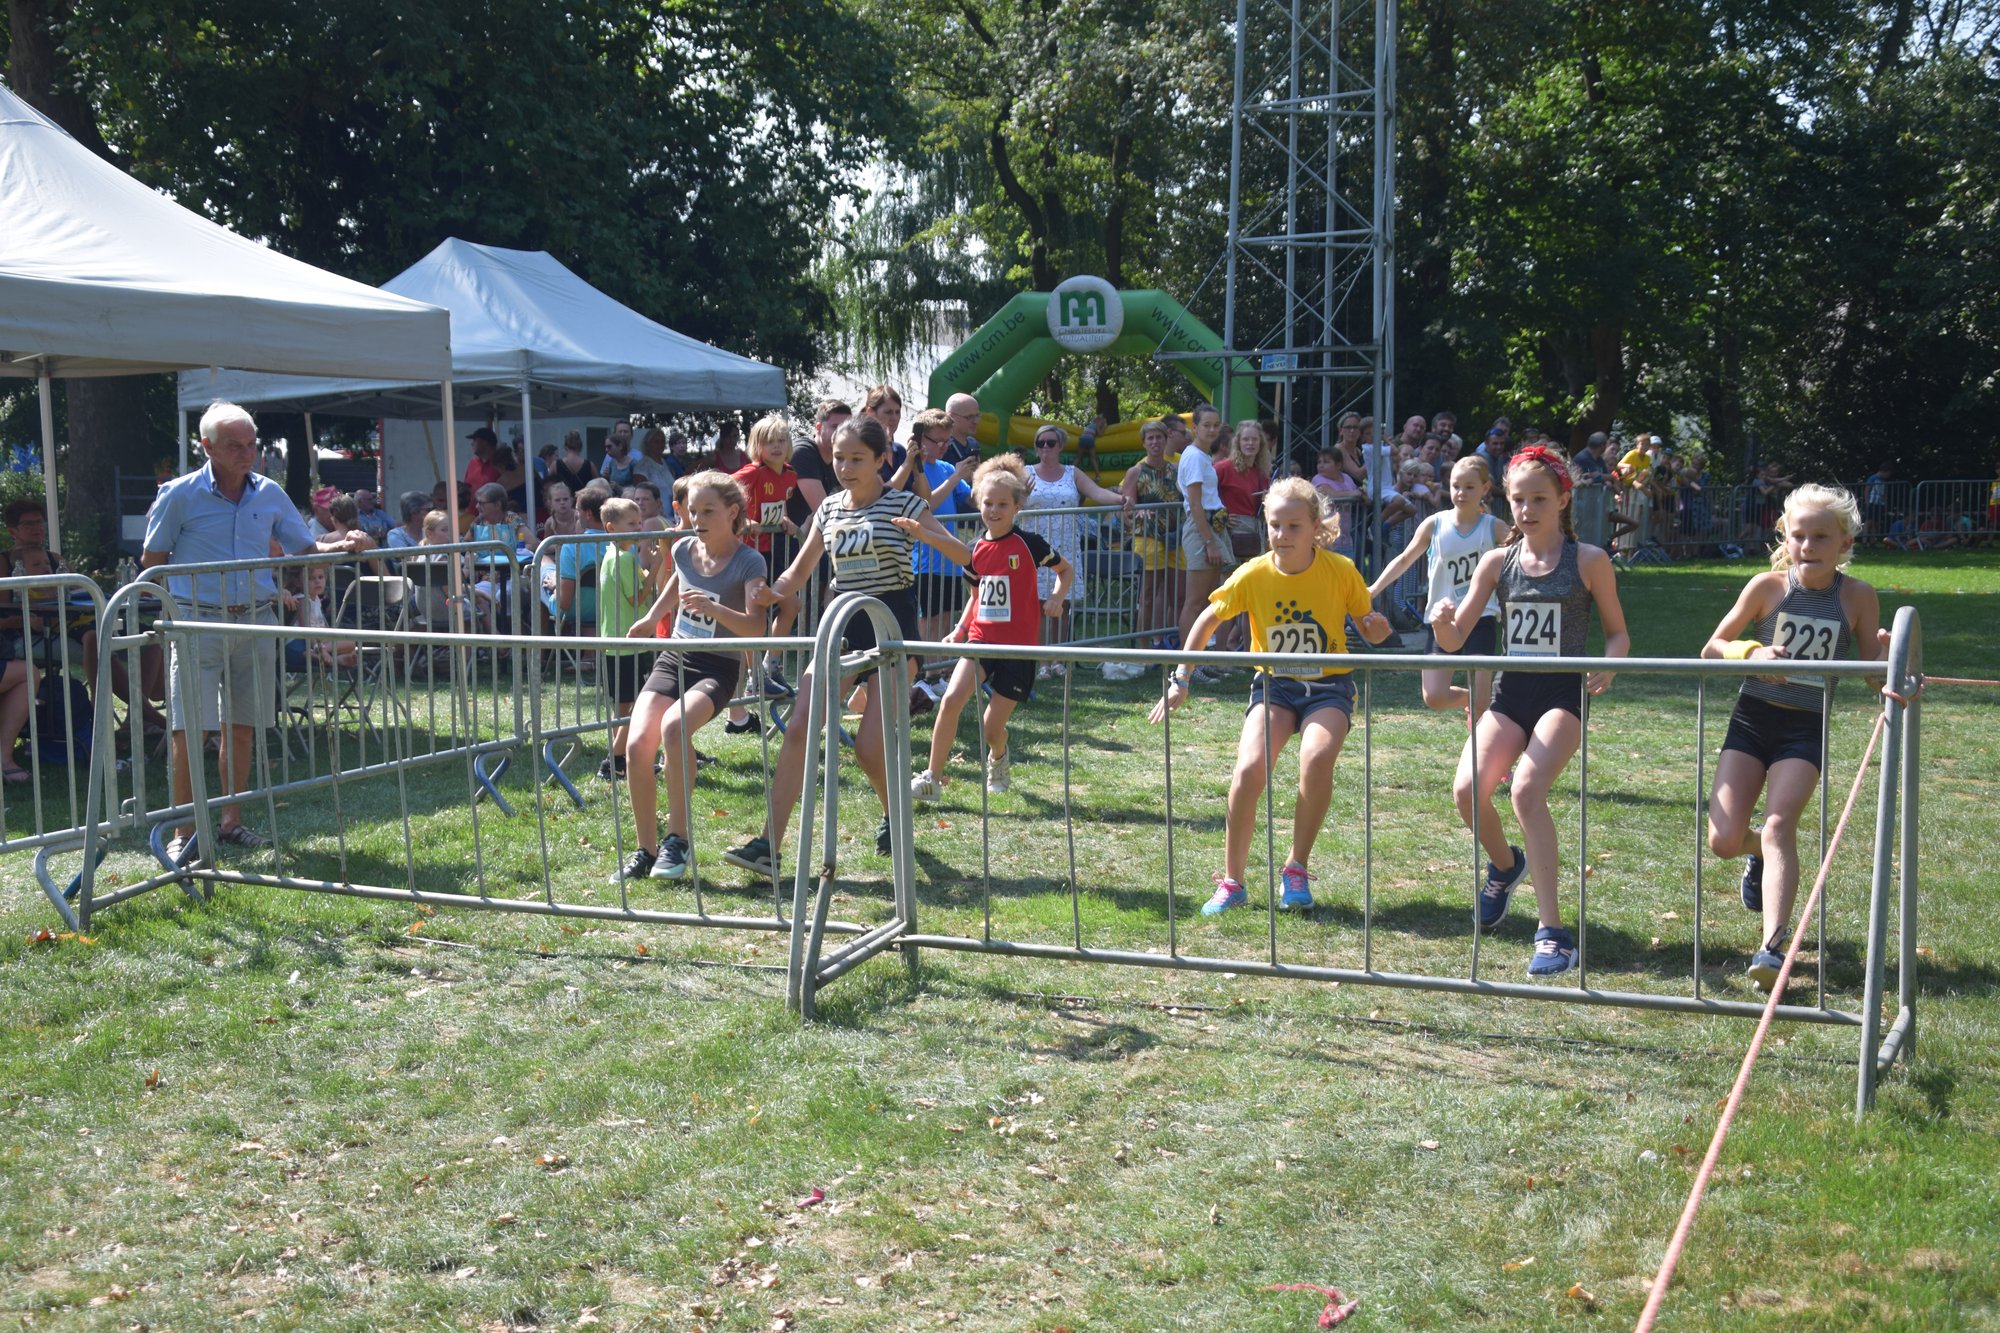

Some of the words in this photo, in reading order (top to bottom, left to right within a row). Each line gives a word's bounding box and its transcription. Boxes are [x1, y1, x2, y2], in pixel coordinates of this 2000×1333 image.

[944, 311, 1025, 382] www.cm.be
[764, 482, 774, 496] 10
[835, 529, 873, 558] 222
[1447, 551, 1479, 586] 227
[980, 580, 1007, 606] 229
[1271, 628, 1318, 654] 225
[1510, 608, 1557, 646] 224
[1780, 620, 1833, 661] 223
